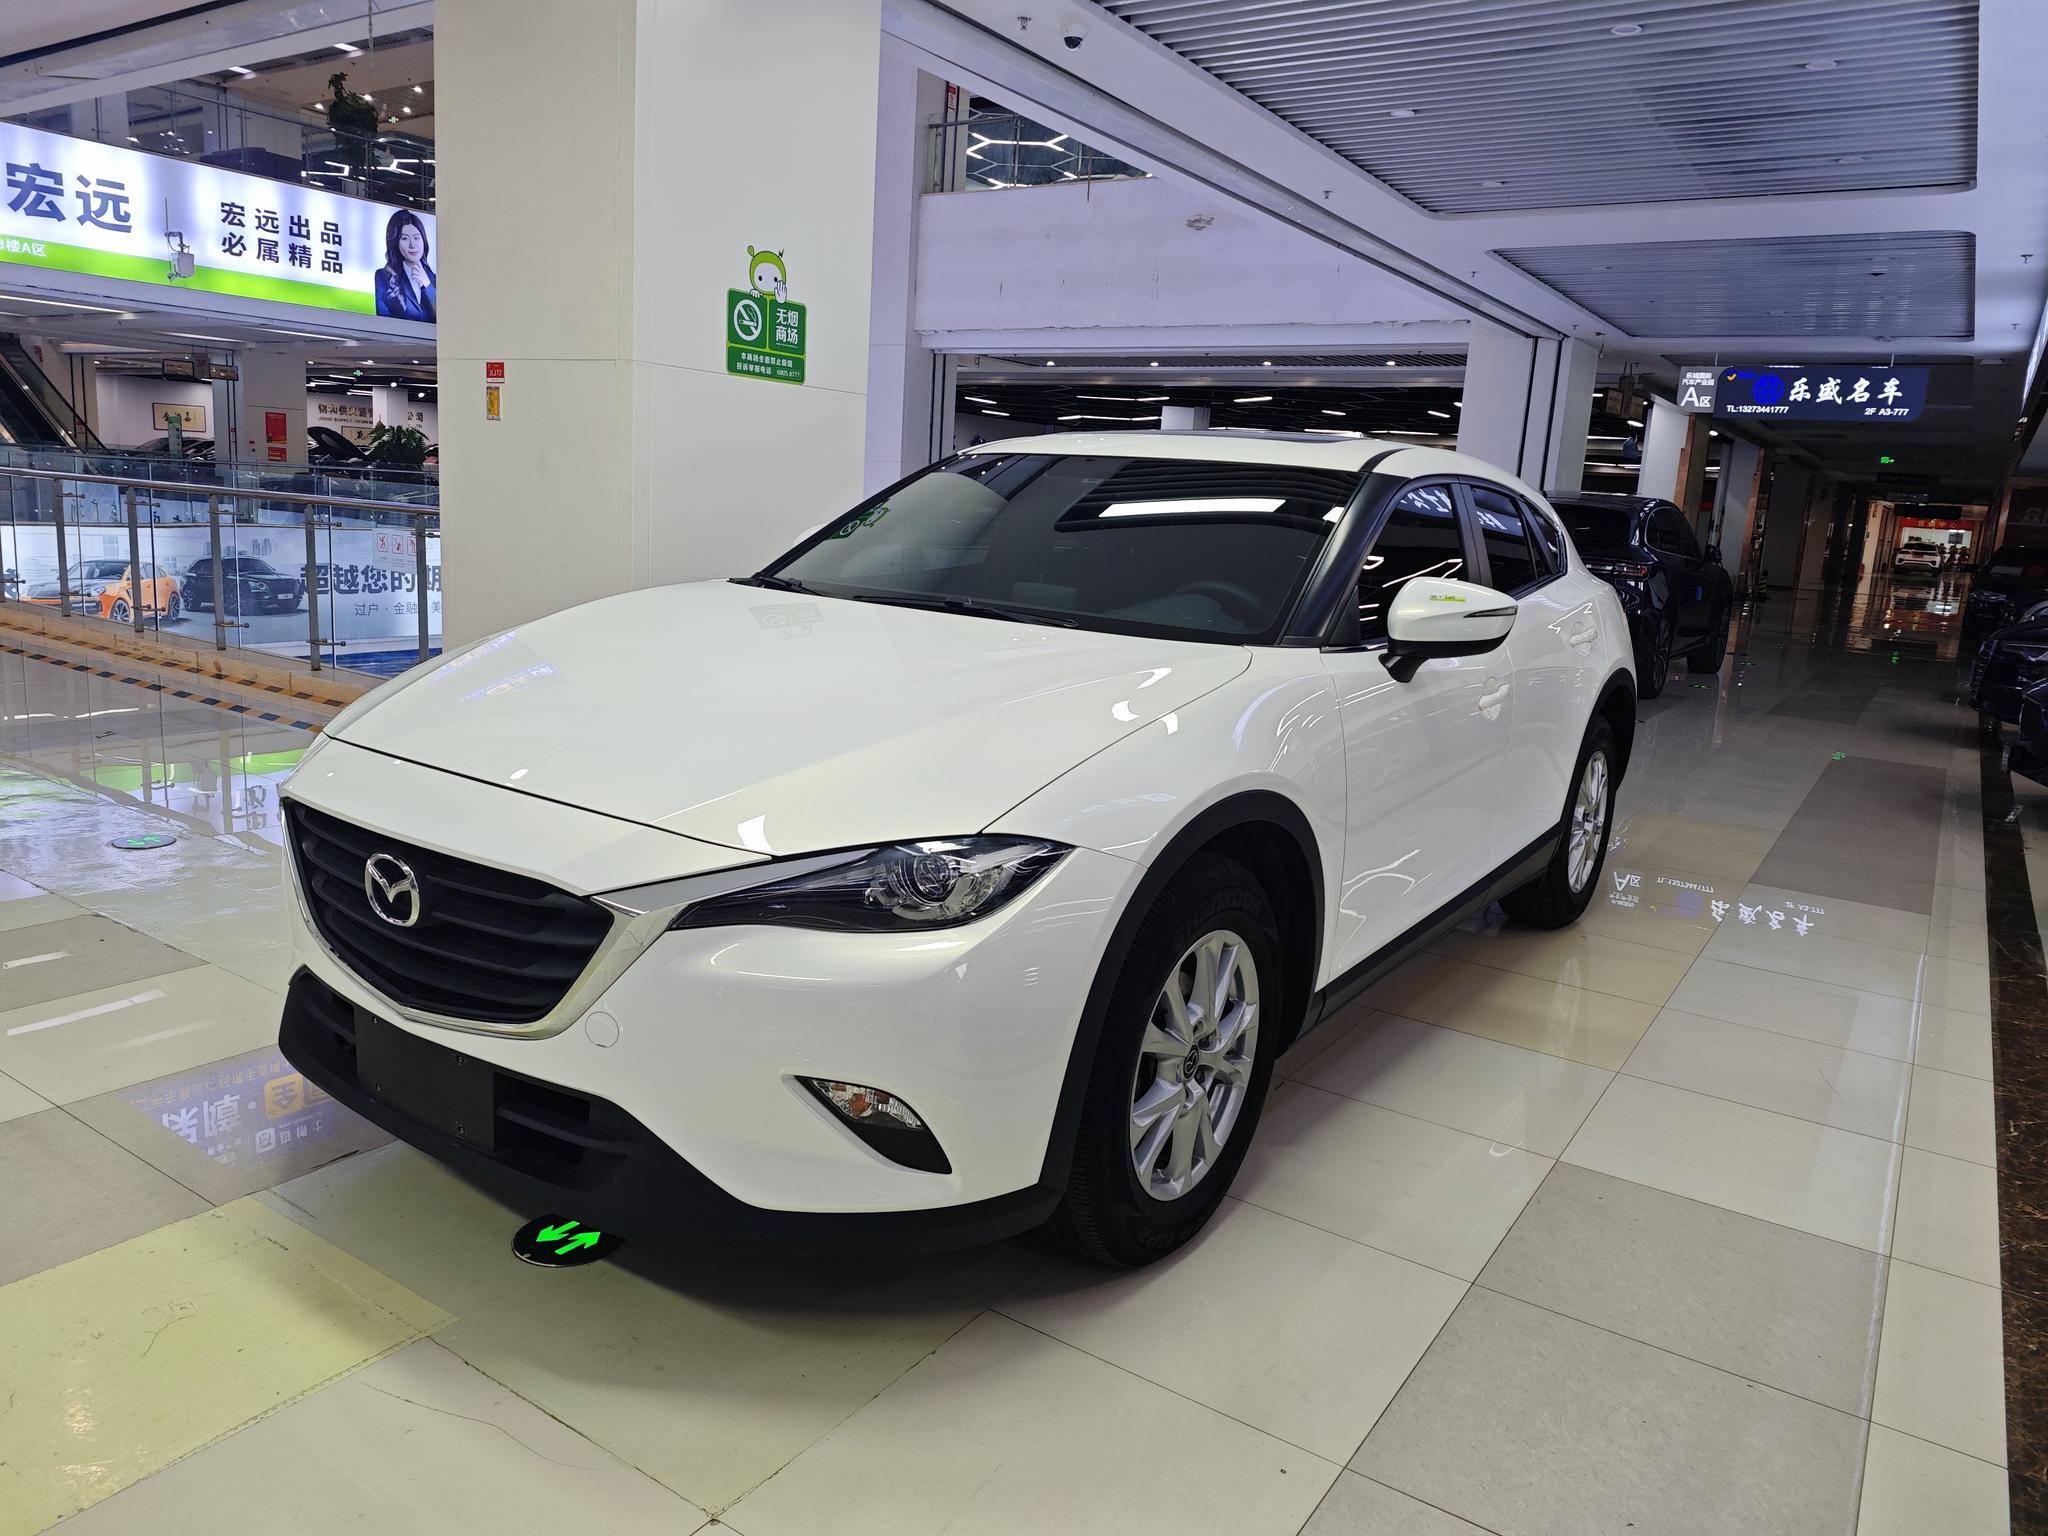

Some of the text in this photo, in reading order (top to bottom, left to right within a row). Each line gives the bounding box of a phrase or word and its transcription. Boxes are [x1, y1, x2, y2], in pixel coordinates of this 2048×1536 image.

[6, 162, 133, 233] 宏远
[220, 201, 343, 246] 宏远出品
[221, 231, 343, 274] 必属精品
[776, 308, 798, 327] 无烟
[776, 326, 798, 345] 商场
[1680, 386, 1712, 408] A区
[1788, 376, 1903, 406] 乐盛名车
[1727, 404, 1790, 414] TL:13273441777
[1864, 407, 1910, 416] 2F A3-777
